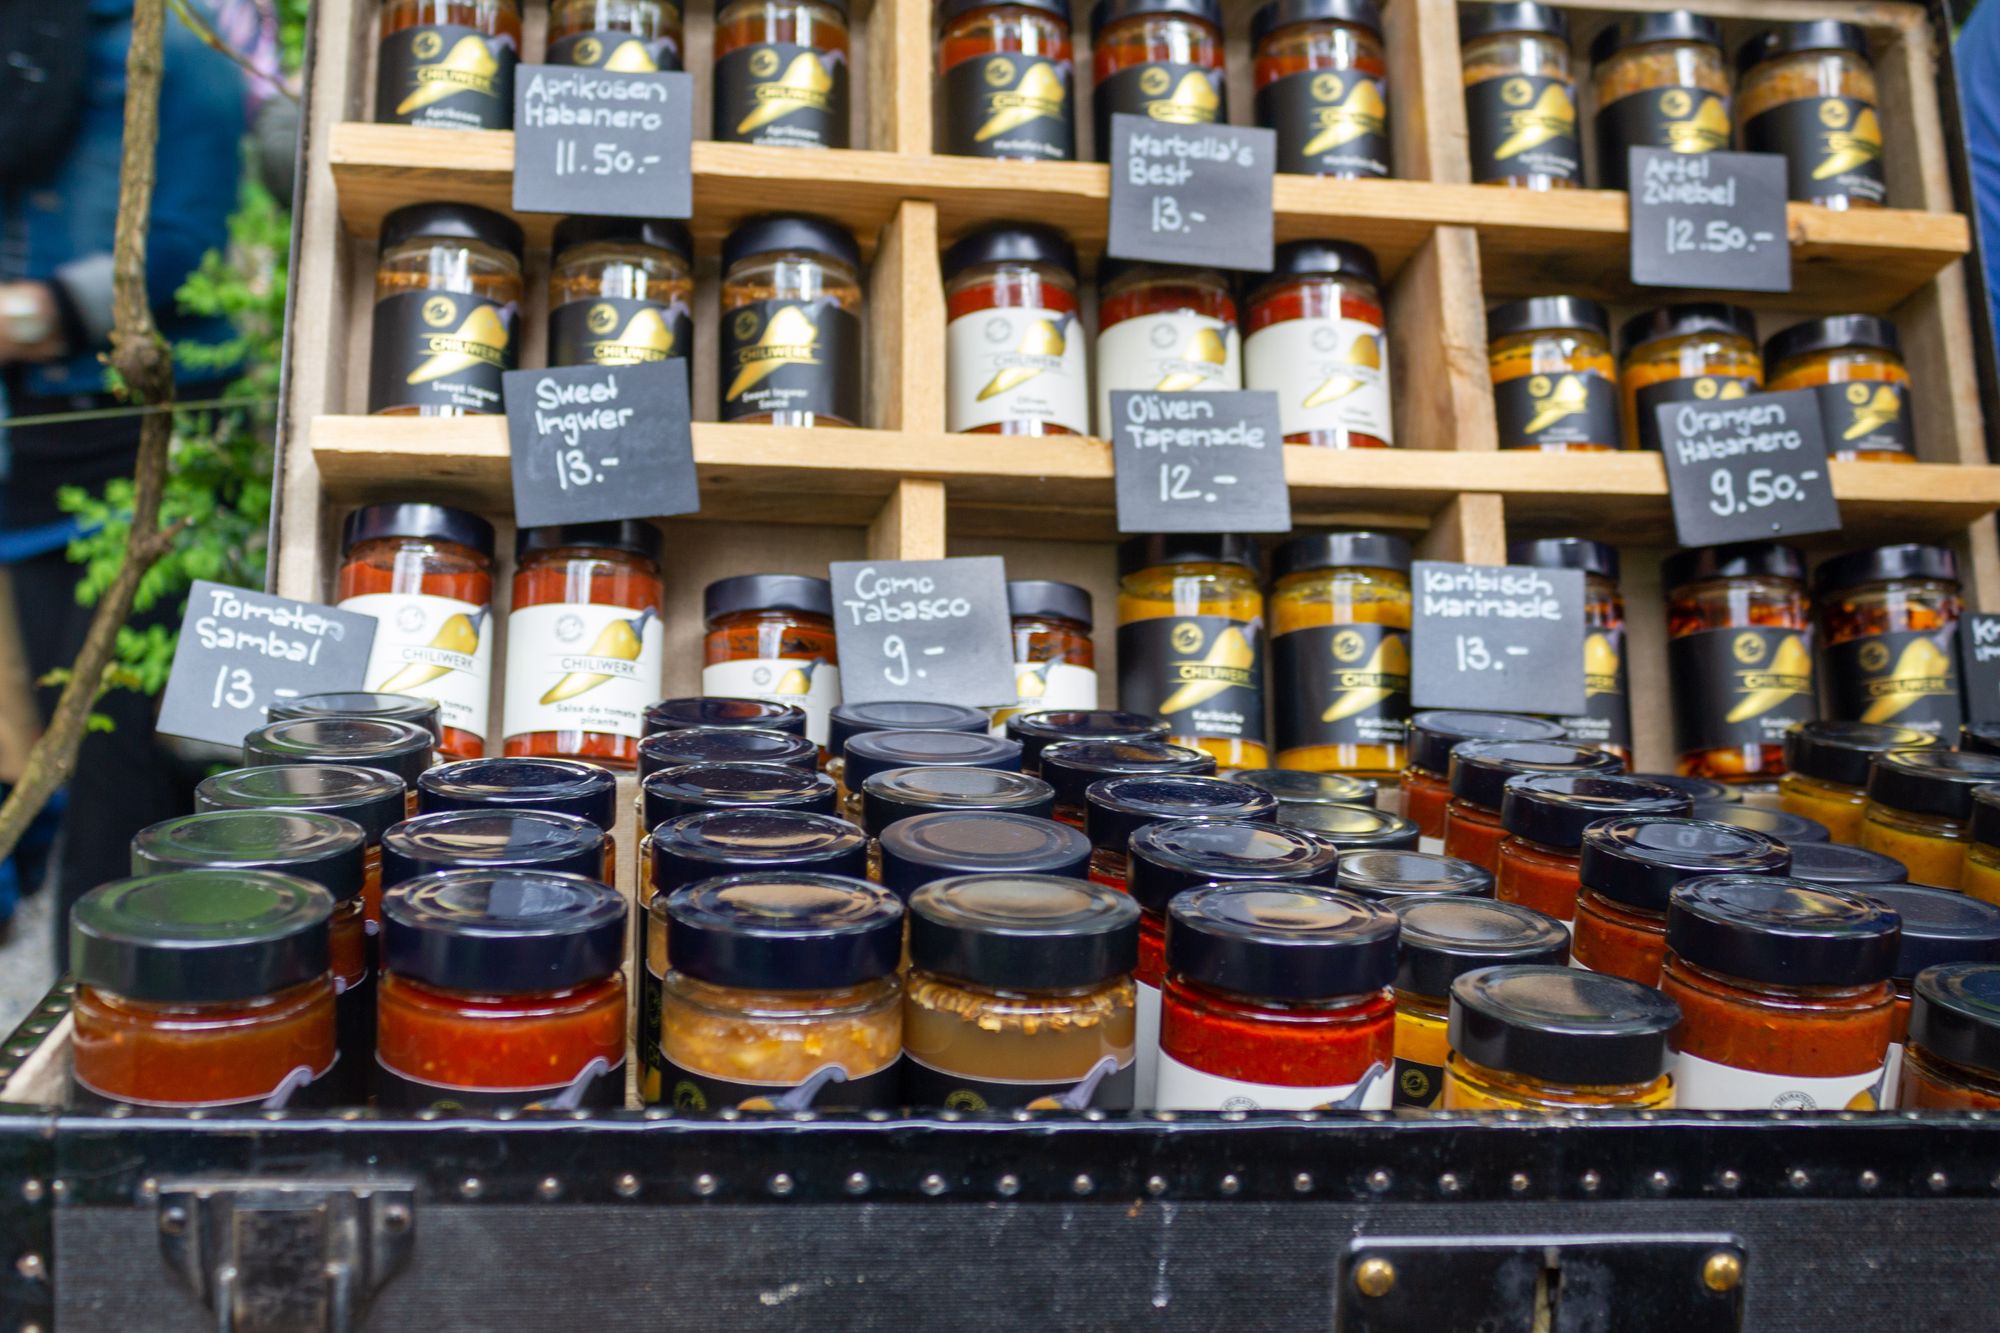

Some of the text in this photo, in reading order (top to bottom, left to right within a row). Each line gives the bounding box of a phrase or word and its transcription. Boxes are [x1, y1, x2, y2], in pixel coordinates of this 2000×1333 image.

[525, 73, 668, 104] Aprikosen
[525, 100, 662, 131] Habanero
[1128, 156, 1194, 186] Best
[1642, 175, 1737, 207] Zwiebel
[536, 373, 619, 410] Sweet
[1127, 394, 1214, 424] Oliven
[1676, 403, 1786, 437] Orangen
[535, 408, 635, 446] Ingwer
[1125, 420, 1266, 454] Tapenade
[1676, 429, 1802, 466] Habanero
[556, 449, 620, 490] 13.-
[1159, 462, 1238, 503] 12.-
[855, 567, 935, 600] Como
[210, 589, 345, 642] Tomaten
[843, 598, 971, 627] Tabasco
[1423, 591, 1562, 621] Marinade
[195, 617, 323, 666] Sambal
[1456, 634, 1530, 672] 13.-
[402, 648, 475, 669] CHILIWERK
[561, 657, 637, 675] CHILIWERK
[556, 703, 584, 714] Salsa
[604, 707, 638, 719] tomate
[580, 716, 620, 728] picante
